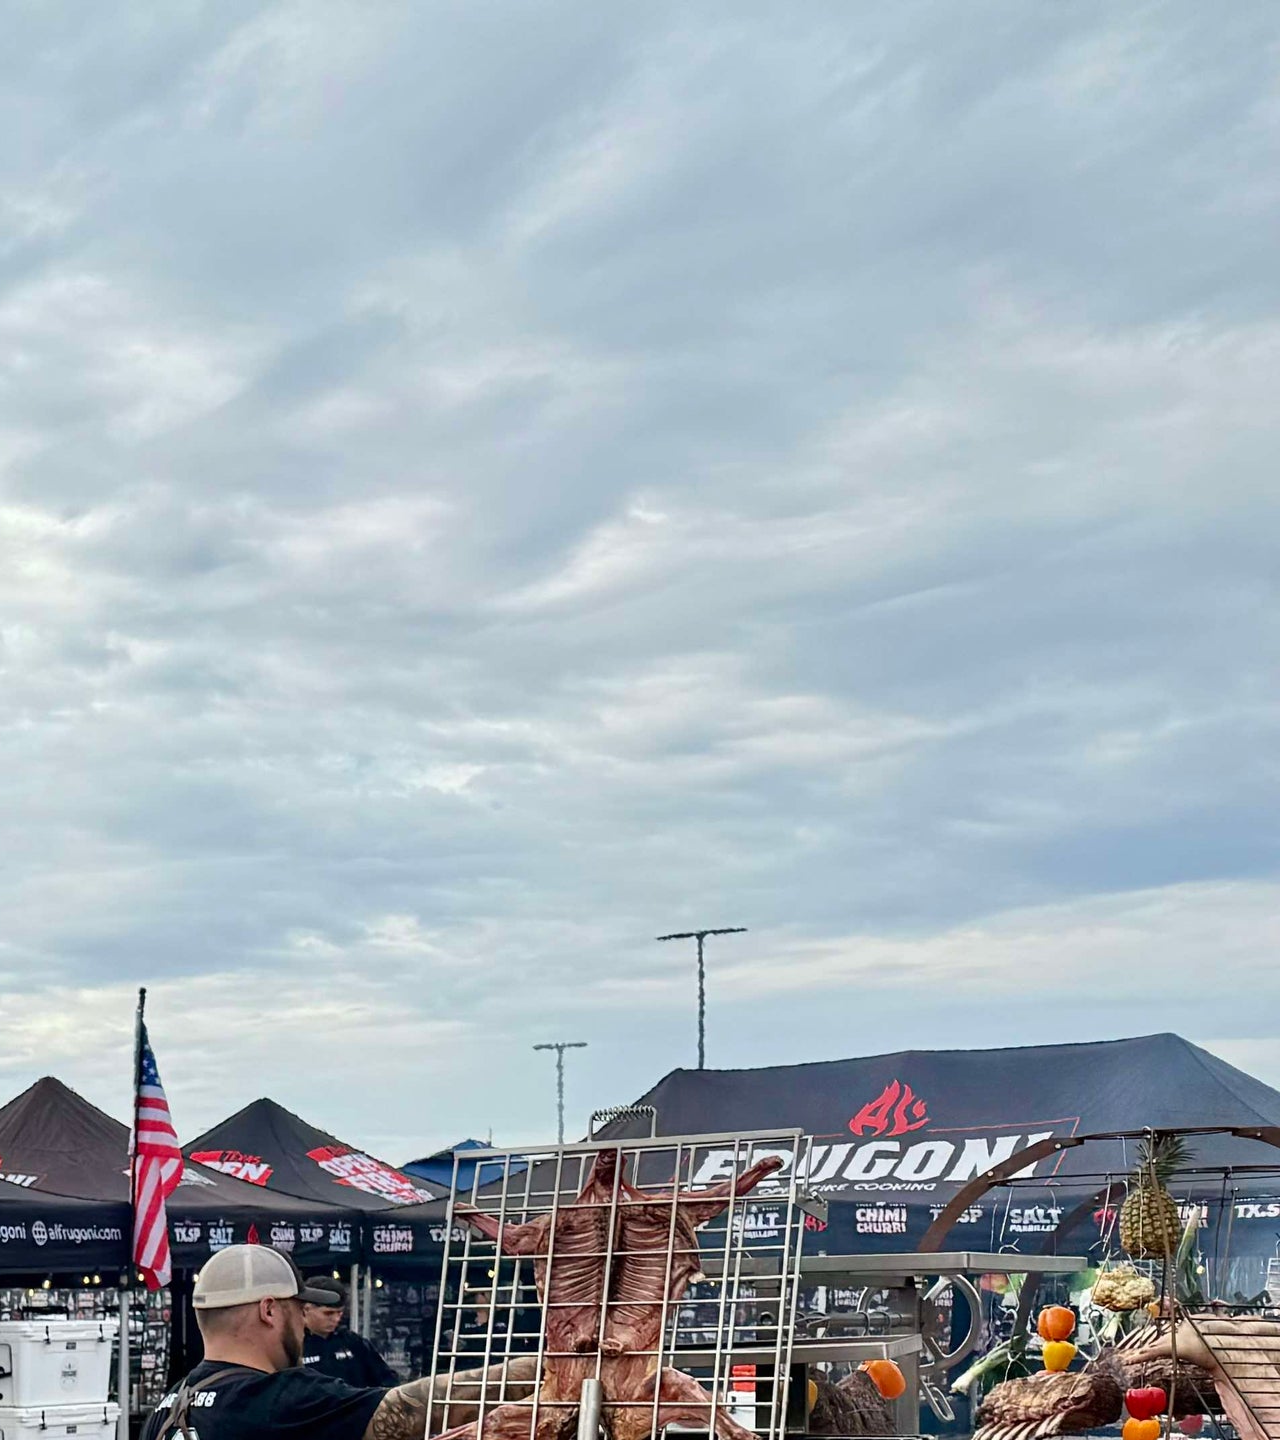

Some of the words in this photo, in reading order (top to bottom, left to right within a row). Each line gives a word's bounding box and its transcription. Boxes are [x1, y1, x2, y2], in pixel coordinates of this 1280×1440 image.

[853, 1181, 938, 1192] COOKING
[855, 1208, 907, 1222] CHIMI
[1009, 1208, 1062, 1225] SALT
[1234, 1204, 1280, 1219] TX.S
[48, 1221, 122, 1244] alfrugoni.com
[855, 1221, 907, 1233] CHURRI
[209, 1226, 234, 1245] SALT
[329, 1228, 351, 1246] SALT
